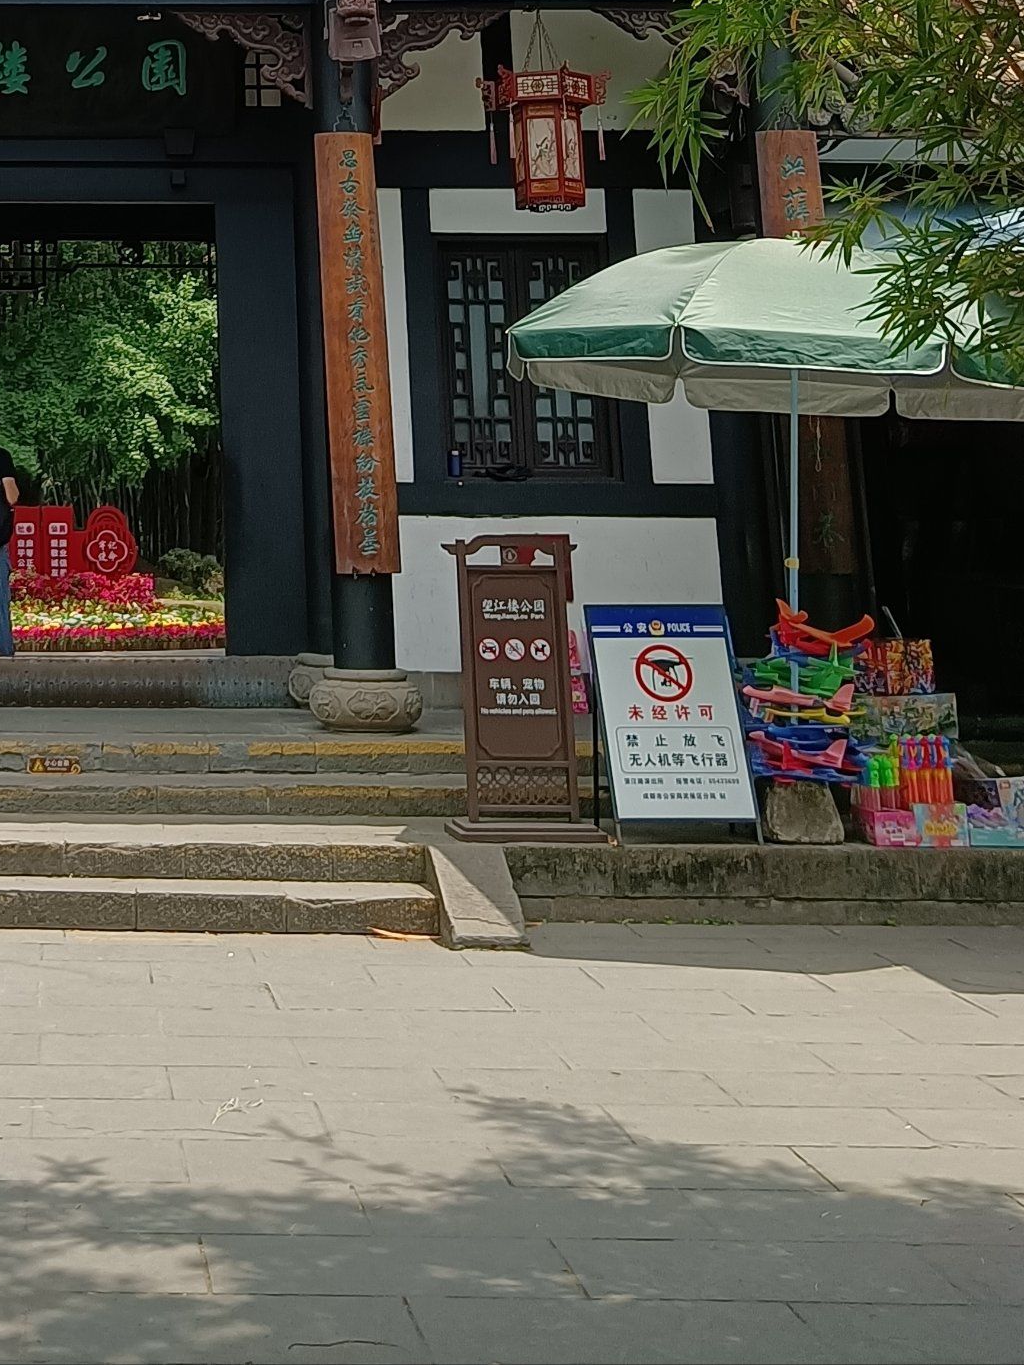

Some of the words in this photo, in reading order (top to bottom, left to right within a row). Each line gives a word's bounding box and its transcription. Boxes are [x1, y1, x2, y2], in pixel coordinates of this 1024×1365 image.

[98, 540, 117, 550] 牢记
[97, 550, 118, 562] 使命
[482, 598, 545, 613] 望江楼公园
[622, 622, 648, 634] 公安
[666, 622, 691, 633] POLICE
[489, 678, 545, 690] 车辆、宠物
[496, 693, 541, 705] 请勿入园
[628, 704, 714, 721] 未经许可
[626, 734, 726, 748] 禁止放飞
[629, 753, 728, 767] 无人机等飞行器
